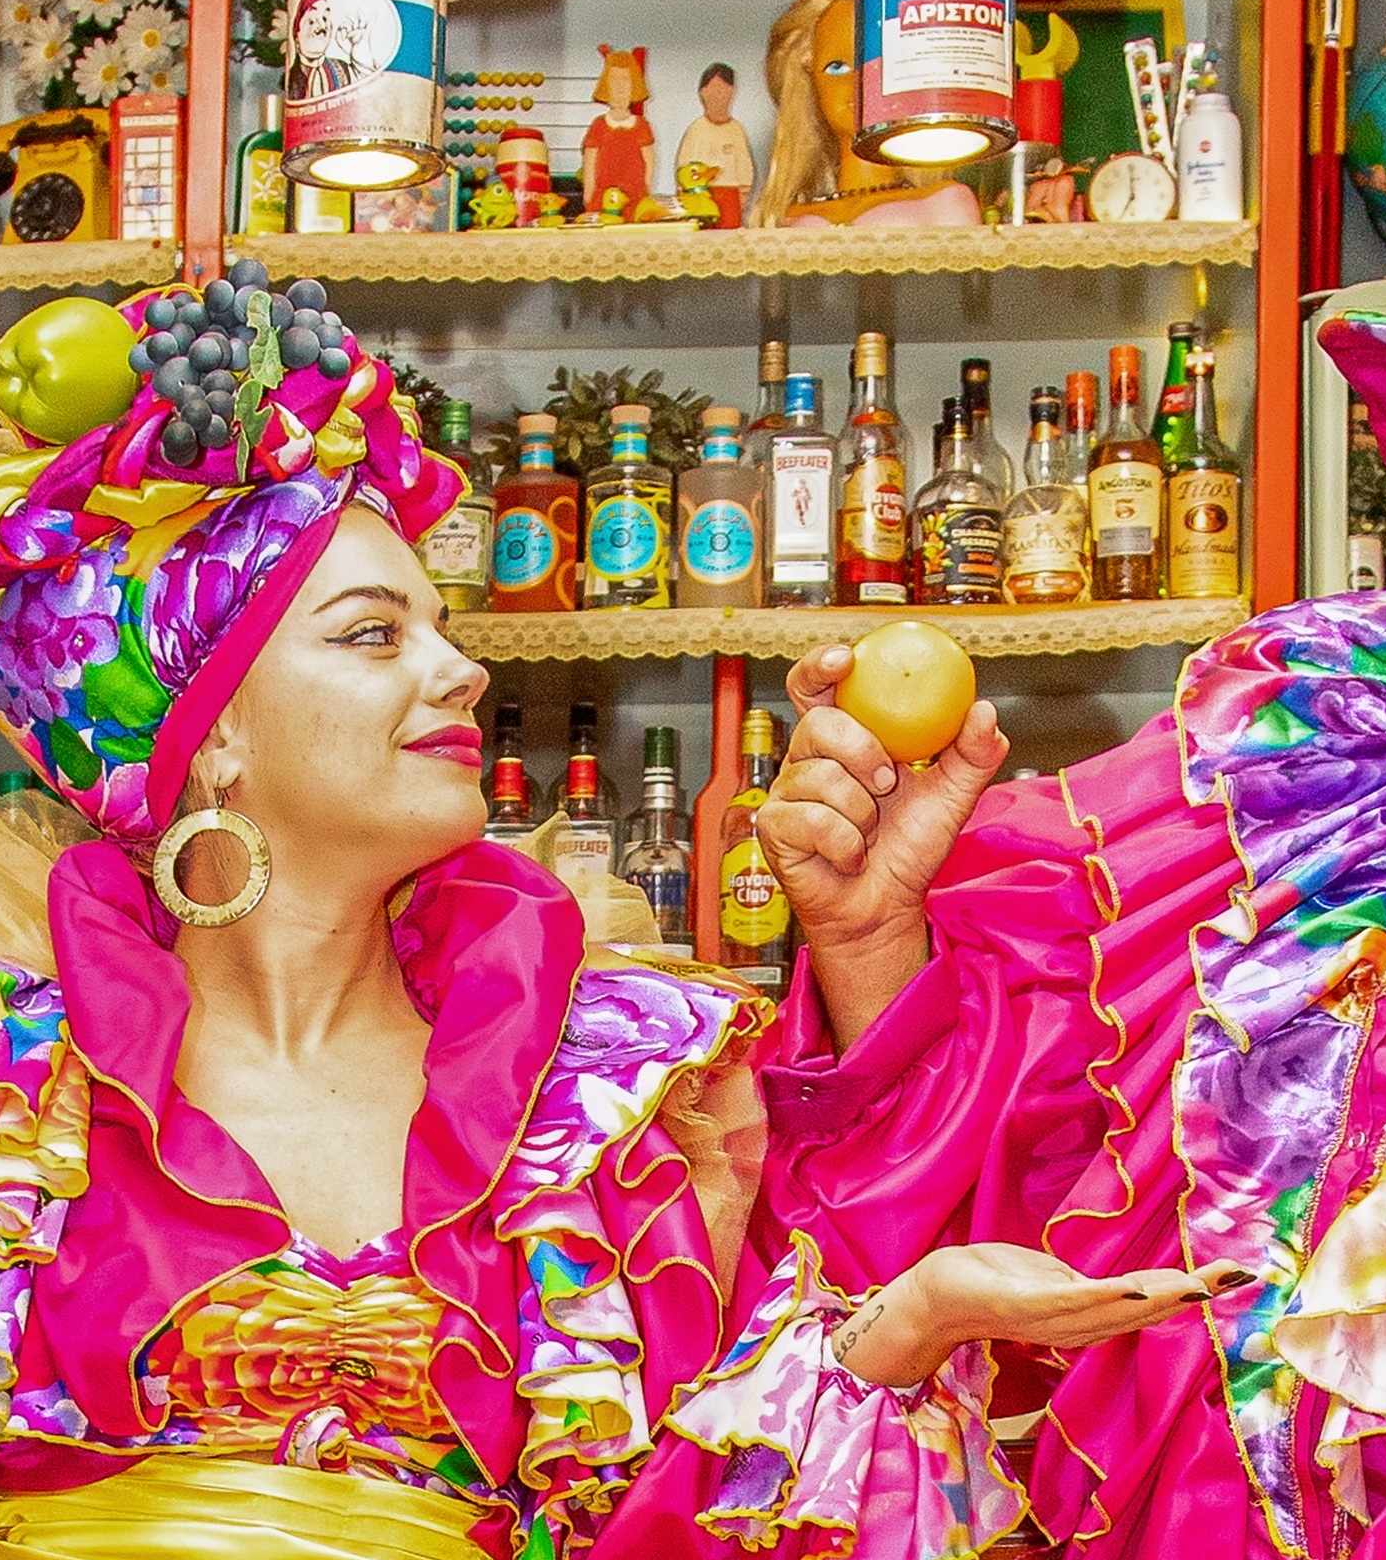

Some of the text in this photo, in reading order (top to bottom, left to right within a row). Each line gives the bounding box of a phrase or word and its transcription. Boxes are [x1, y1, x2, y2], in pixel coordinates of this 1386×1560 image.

[902, 2, 1004, 28] ΑΡΙΣΤΟΝ
[775, 455, 829, 471] BEEFEATER
[1177, 477, 1233, 501] Tito's
[728, 873, 778, 888] Havana
[736, 888, 770, 903] Club
